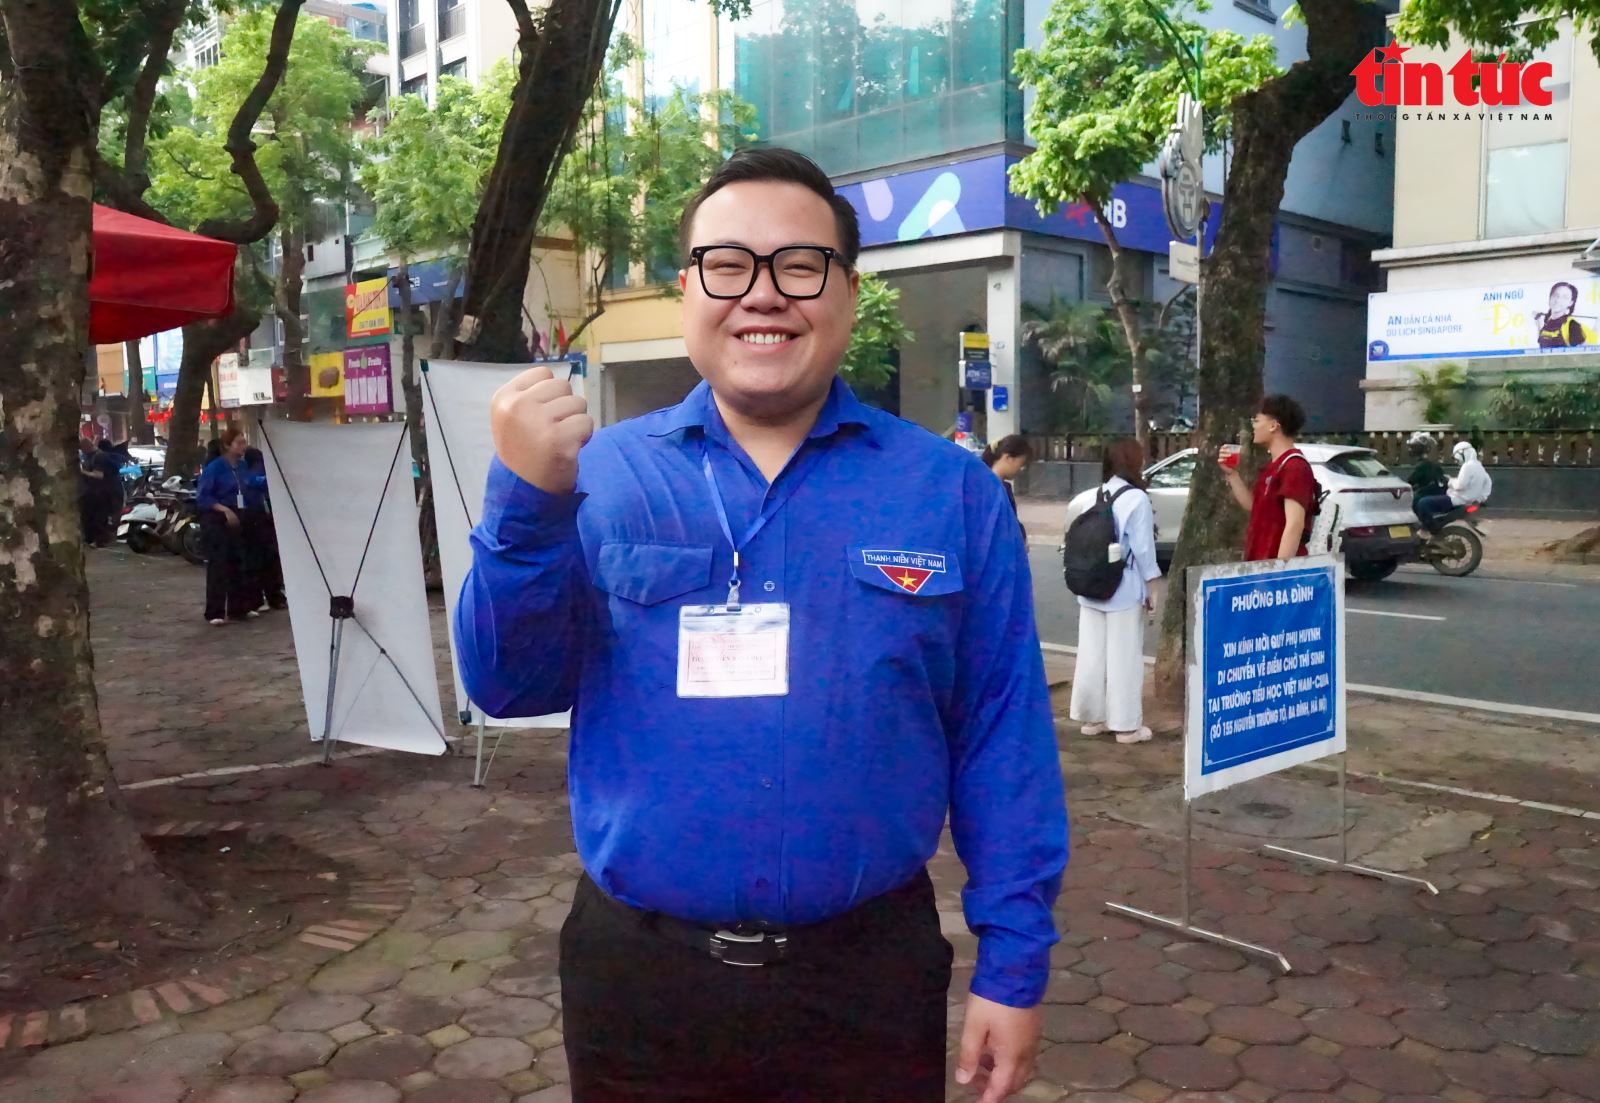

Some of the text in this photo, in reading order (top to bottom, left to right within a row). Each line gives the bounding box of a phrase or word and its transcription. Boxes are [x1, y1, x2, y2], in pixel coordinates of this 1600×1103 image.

[1483, 292, 1503, 301] ANH
[1418, 324, 1463, 336] SINGAPORE
[866, 554, 891, 562] THANH
[910, 556, 927, 567] VIỆT
[928, 560, 942, 568] NAM
[1231, 584, 1314, 612] PHƯỜNG BA ĐÌNH
[1223, 627, 1321, 658] XIN KÍNH MỜI QUÝ PHỤ HUYNH
[1299, 649, 1310, 667] THÍ
[1310, 650, 1325, 667] SINH
[1208, 697, 1220, 716] TẠI
[1221, 689, 1251, 710] TRƯỜNG
[1266, 683, 1282, 702] HỌC
[1283, 677, 1297, 698] VIỆT
